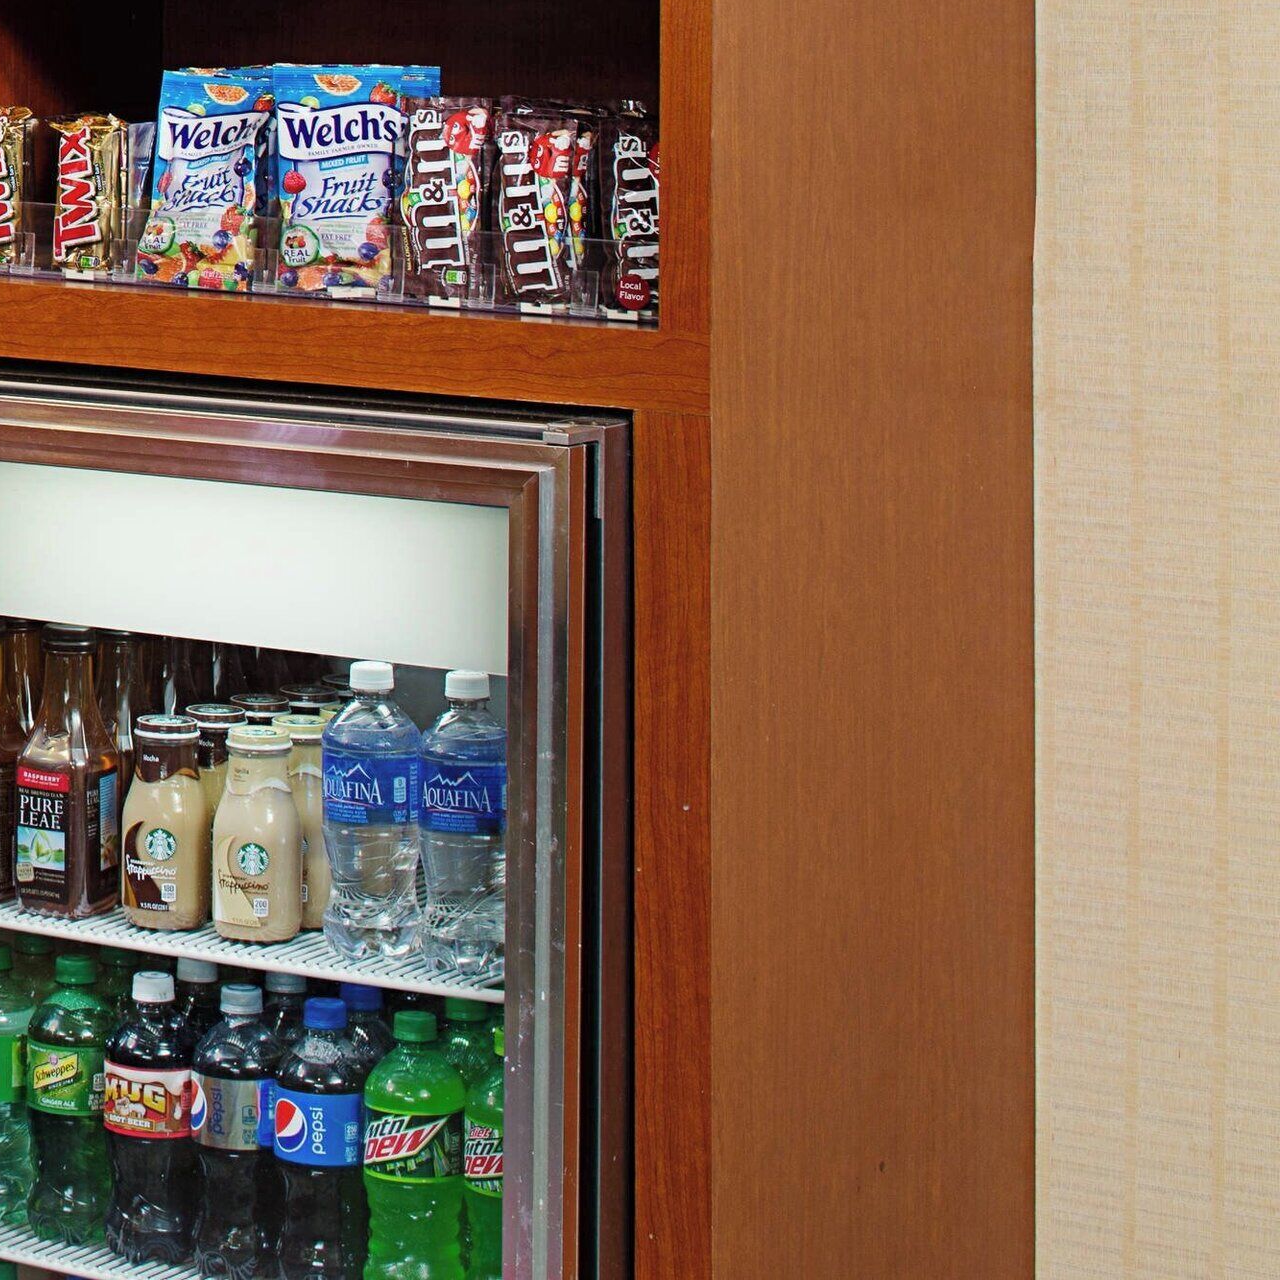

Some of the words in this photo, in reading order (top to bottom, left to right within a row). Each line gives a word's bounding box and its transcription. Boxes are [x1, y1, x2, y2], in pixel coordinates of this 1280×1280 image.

[283, 110, 398, 150] Welch's
[345, 155, 367, 166] FRUIT
[181, 168, 232, 191] Fruit
[321, 172, 378, 198] Fruit
[54, 126, 101, 260] TWIX
[298, 190, 384, 216] Snacks
[283, 250, 311, 258] REAL
[620, 280, 643, 291] Local
[619, 291, 645, 302] Flavor
[142, 753, 160, 763] Mocha
[23, 771, 61, 783] RASPBERRY
[322, 773, 384, 806] AQUAFINA
[422, 781, 493, 814] AQUAFINA
[19, 794, 65, 815] PURE
[19, 809, 61, 830] LEAF
[35, 1061, 76, 1082] Schweppes
[41, 1096, 63, 1106] GINGER
[105, 1076, 167, 1114] MUG
[210, 1087, 225, 1136] pepsi
[127, 1117, 151, 1128] BEER
[310, 1107, 327, 1155] pepsi
